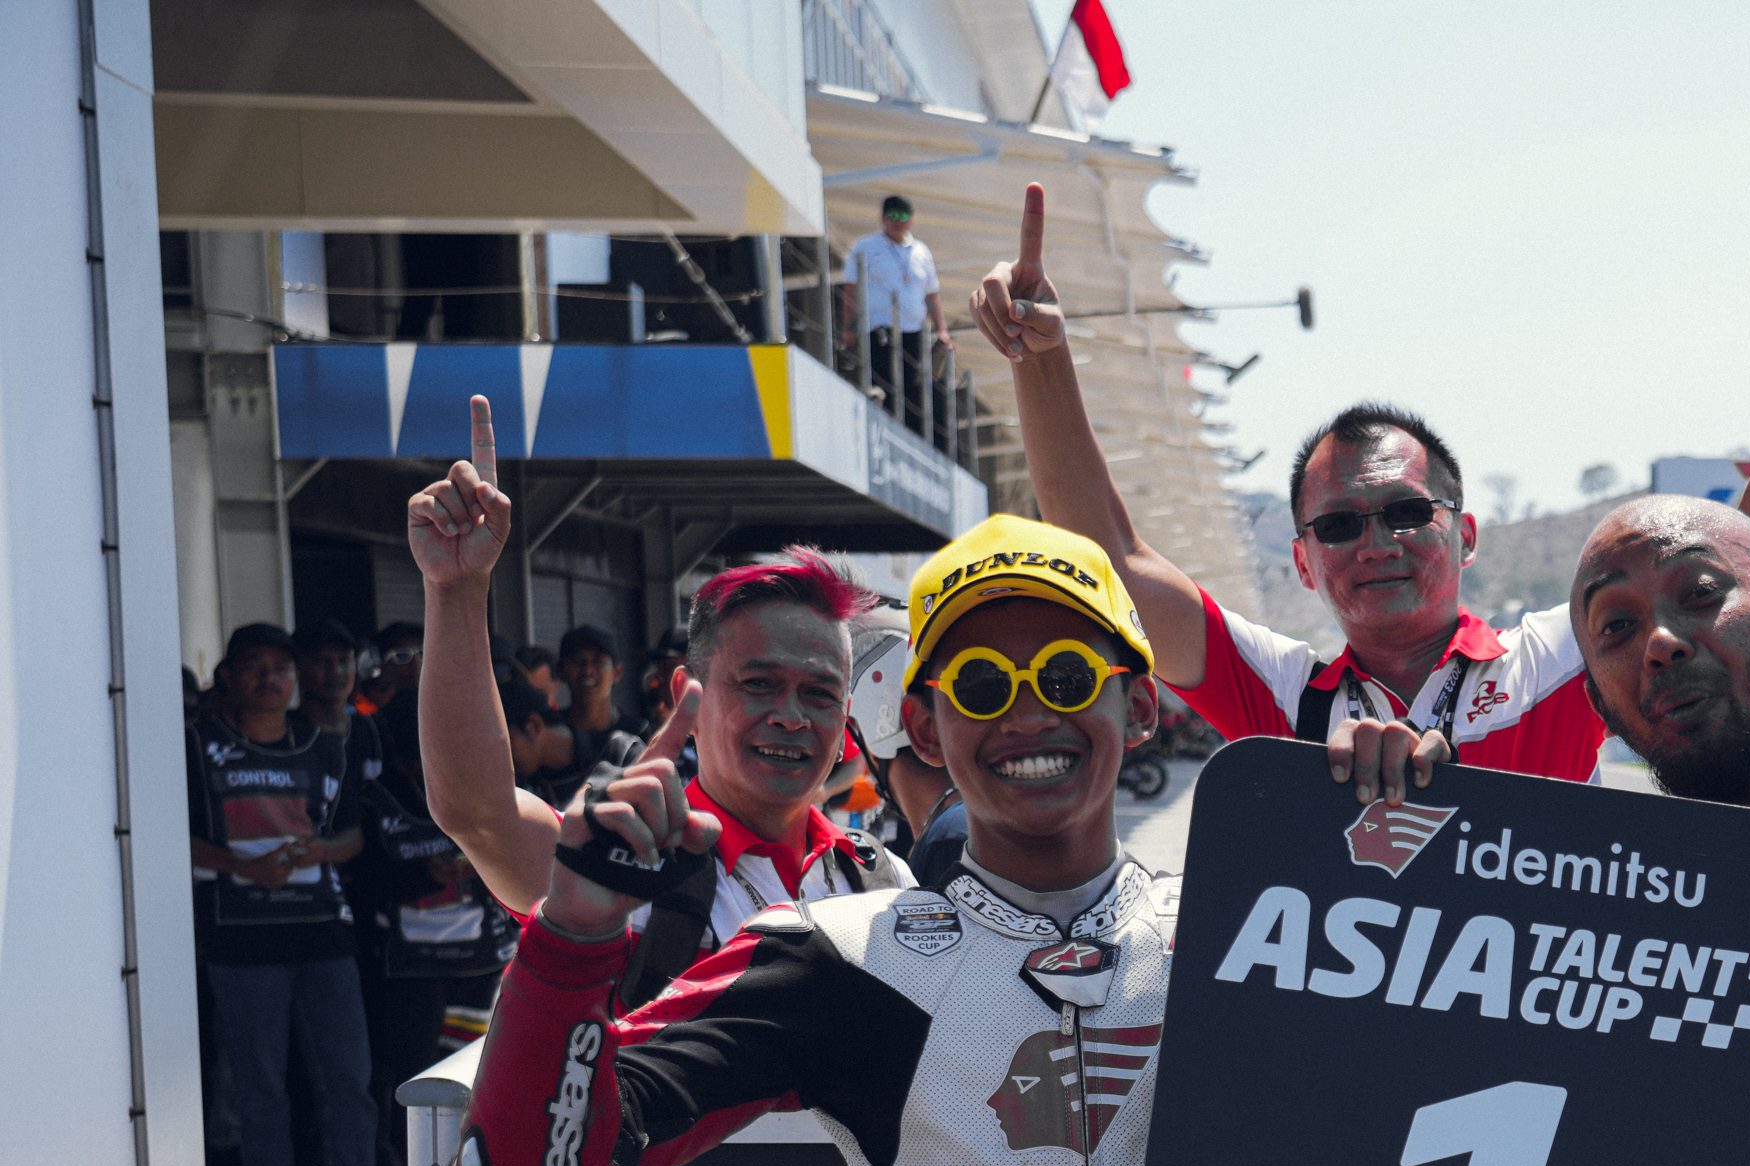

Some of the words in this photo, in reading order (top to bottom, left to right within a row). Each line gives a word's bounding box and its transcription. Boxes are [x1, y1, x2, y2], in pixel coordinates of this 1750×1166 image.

[939, 552, 1099, 597] DUNLOP
[227, 770, 295, 787] CONTROL
[1455, 822, 1707, 908] idemitsu
[903, 906, 934, 914] ROAD
[904, 933, 954, 942] ROOKIES
[918, 942, 941, 950] CUP
[1214, 886, 1515, 1019] ASIA
[1529, 923, 1750, 996] TALENT
[1520, 977, 1644, 1033] CUP
